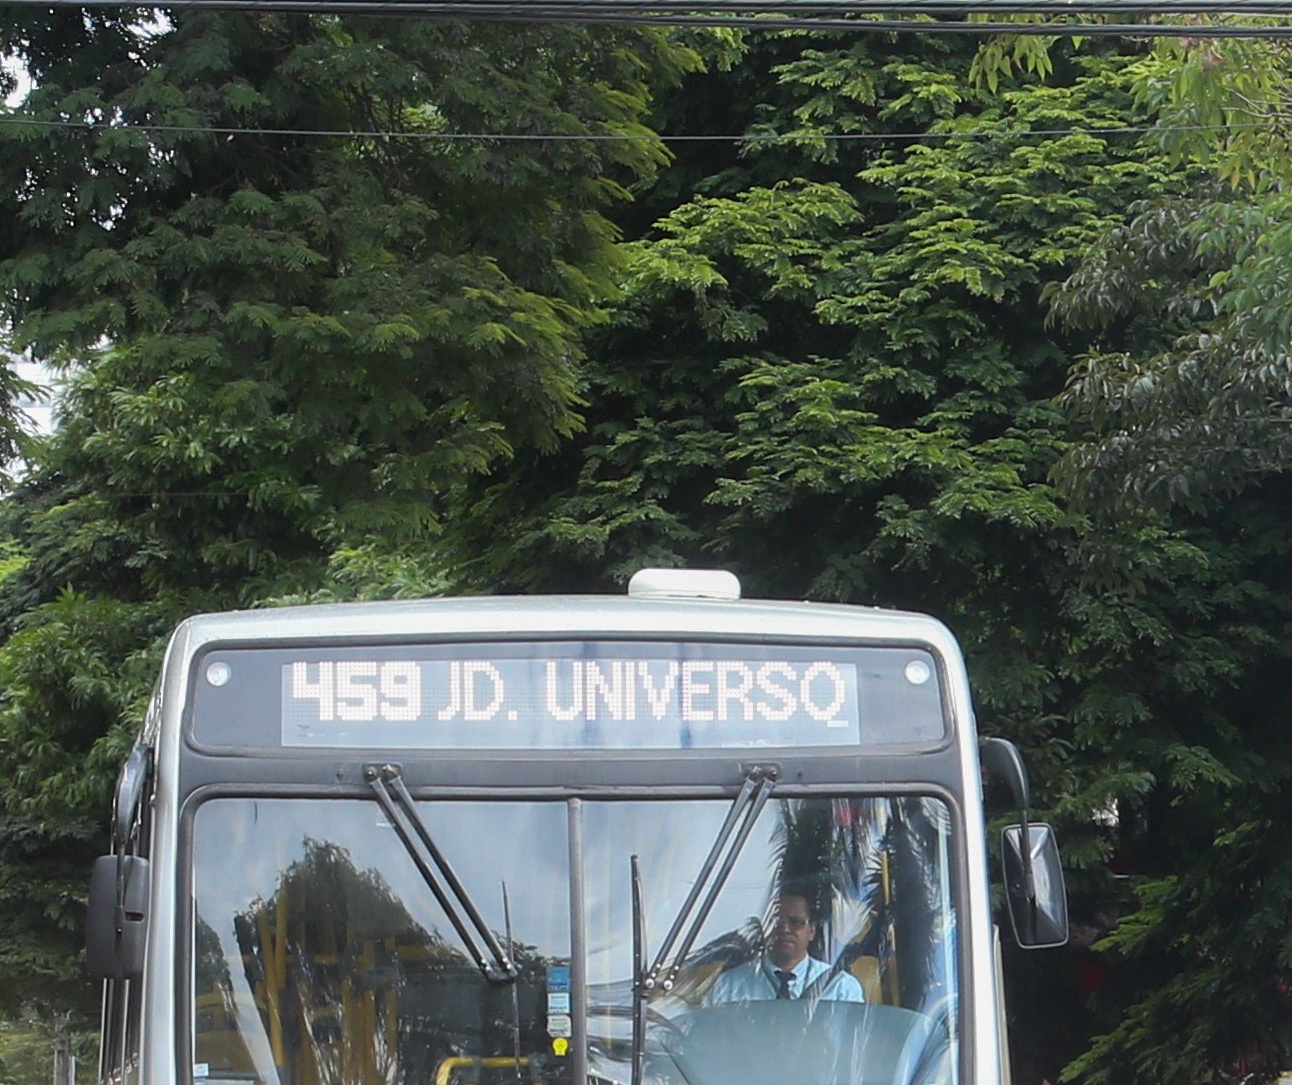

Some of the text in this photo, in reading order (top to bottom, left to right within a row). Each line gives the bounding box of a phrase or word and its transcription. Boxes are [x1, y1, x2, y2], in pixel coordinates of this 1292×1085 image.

[292, 661, 846, 721] 459 JD. UNIVERSO
